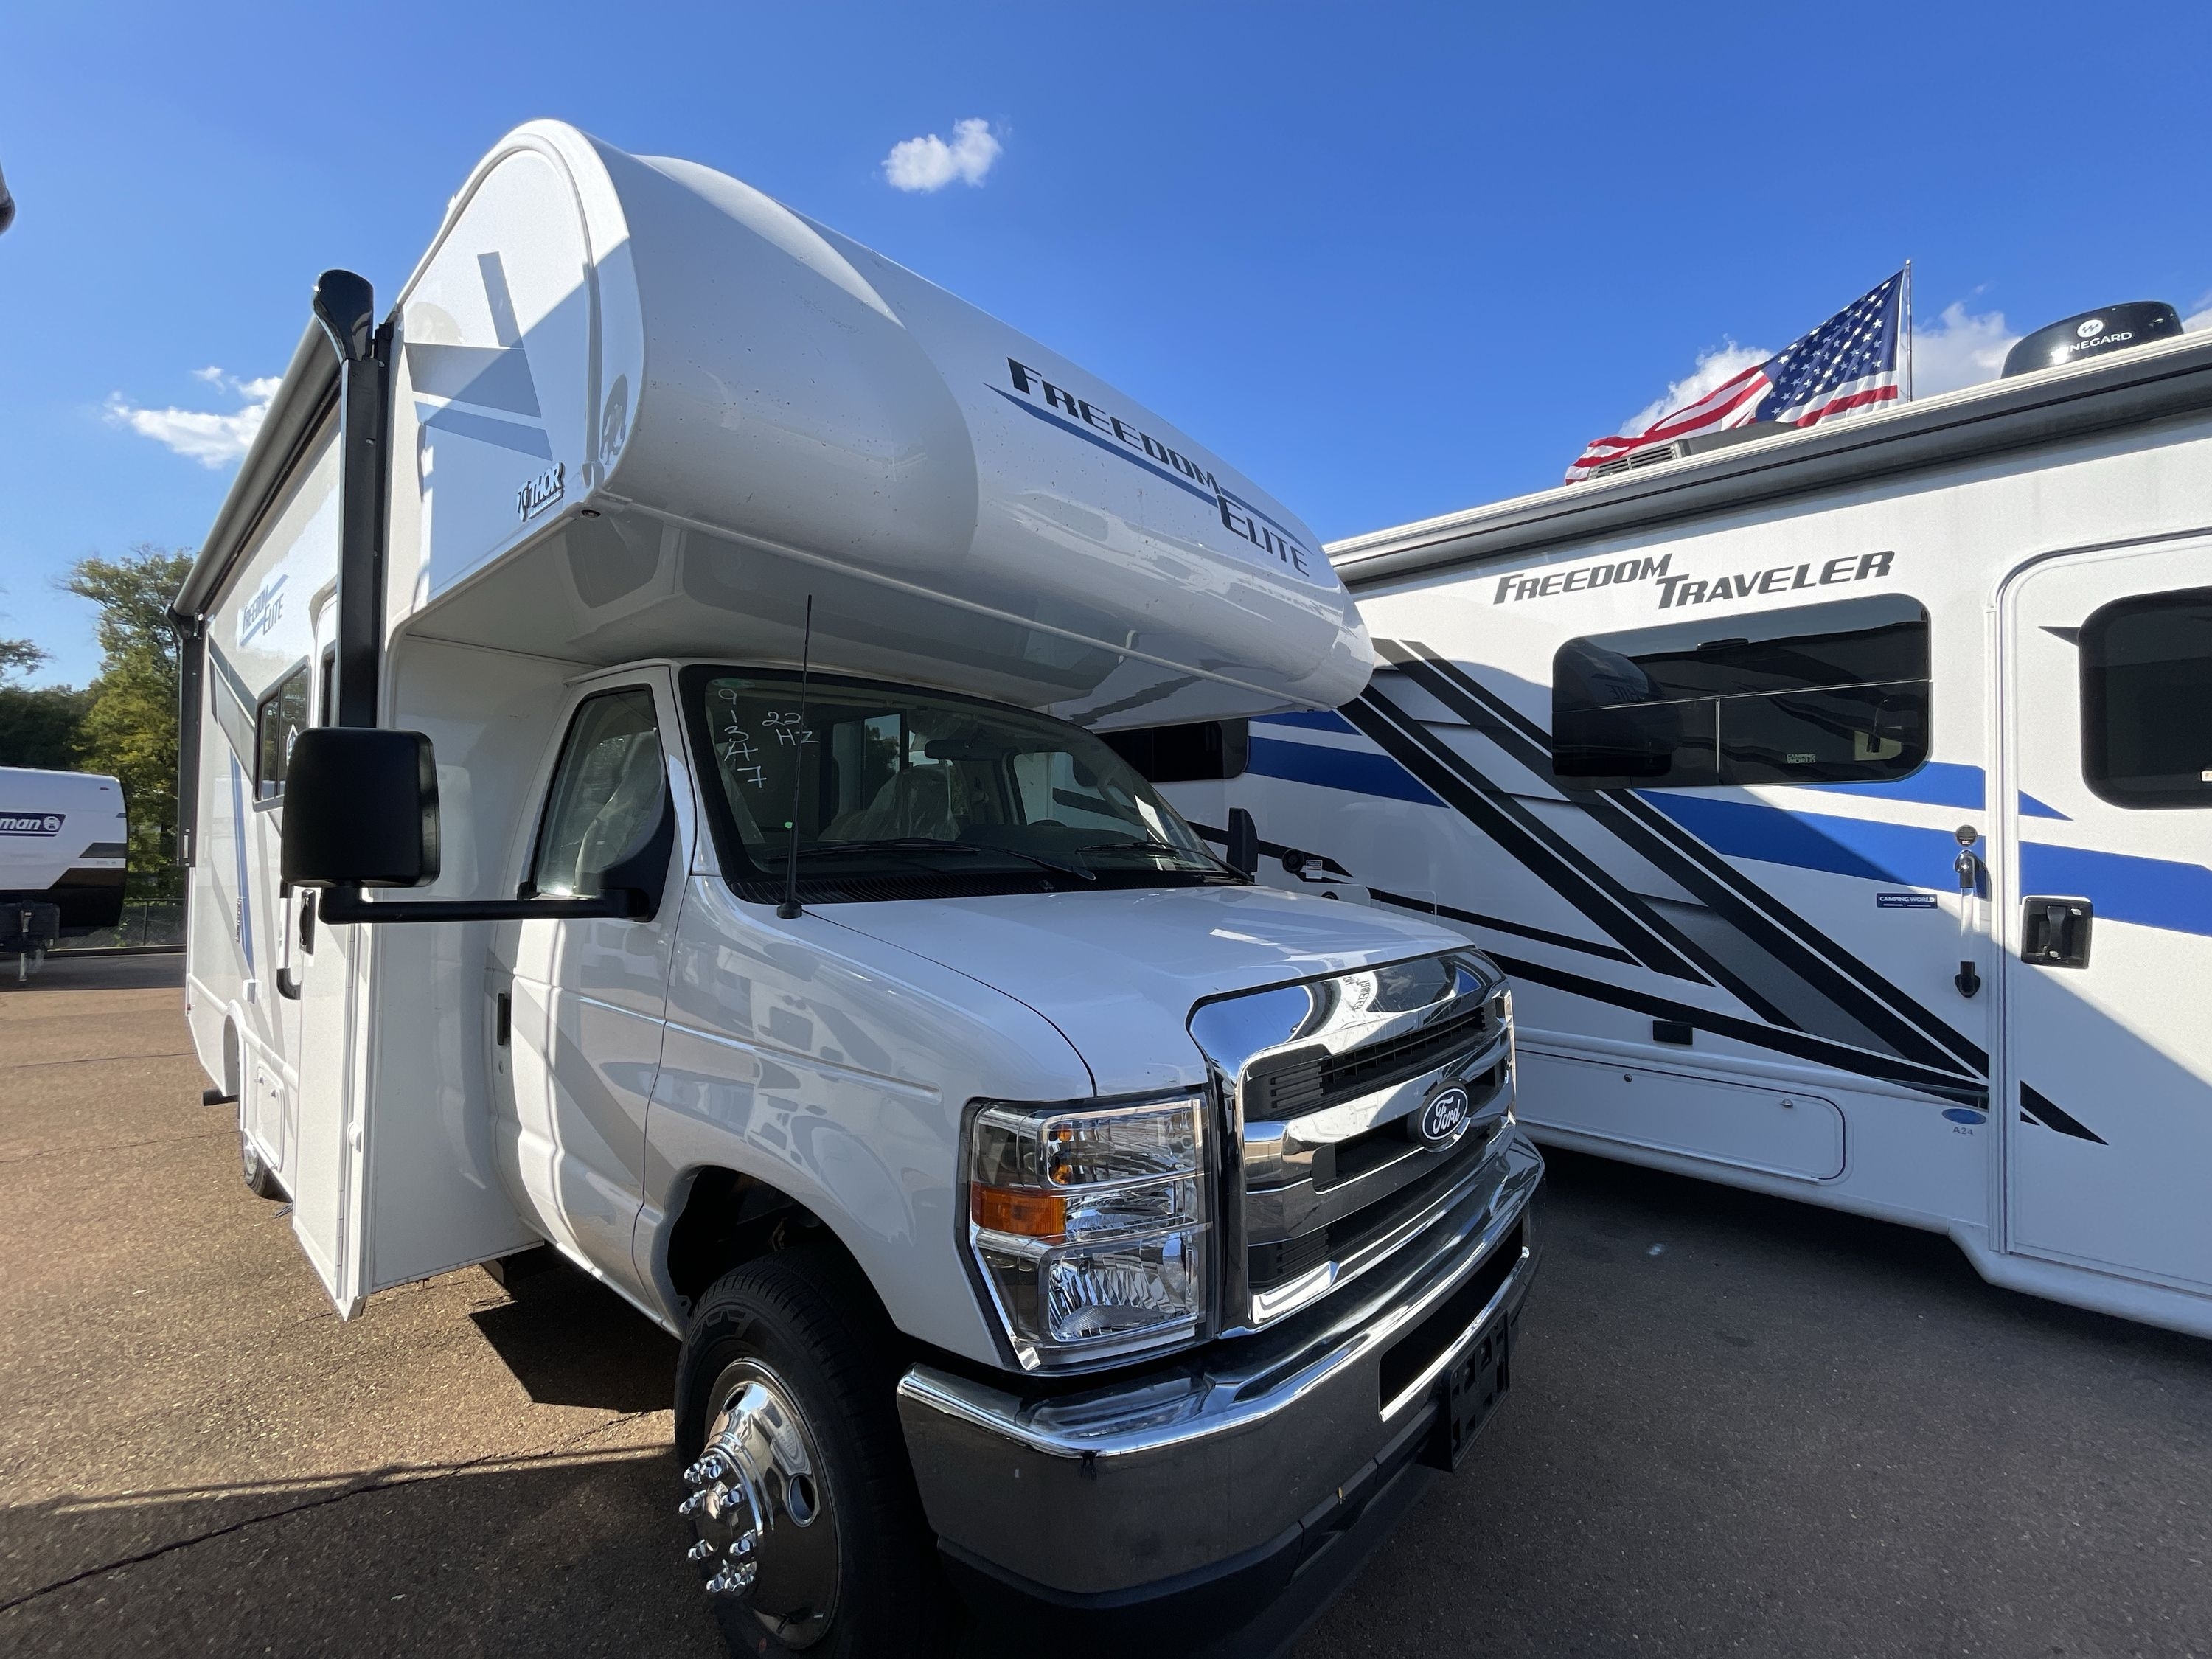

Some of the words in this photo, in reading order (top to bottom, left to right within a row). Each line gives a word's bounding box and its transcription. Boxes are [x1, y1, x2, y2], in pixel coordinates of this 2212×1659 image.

[2064, 331, 2133, 354] NEGARD
[1006, 357, 1222, 495] FREEDOM
[527, 462, 564, 509] THOR
[1217, 494, 1310, 577] ELITE
[1492, 553, 1673, 605] FREEDOM
[1657, 550, 1896, 609] TRAVELER
[762, 711, 803, 727] 22
[1433, 1096, 1461, 1135] Ford
[1952, 1126, 1974, 1135] A24
